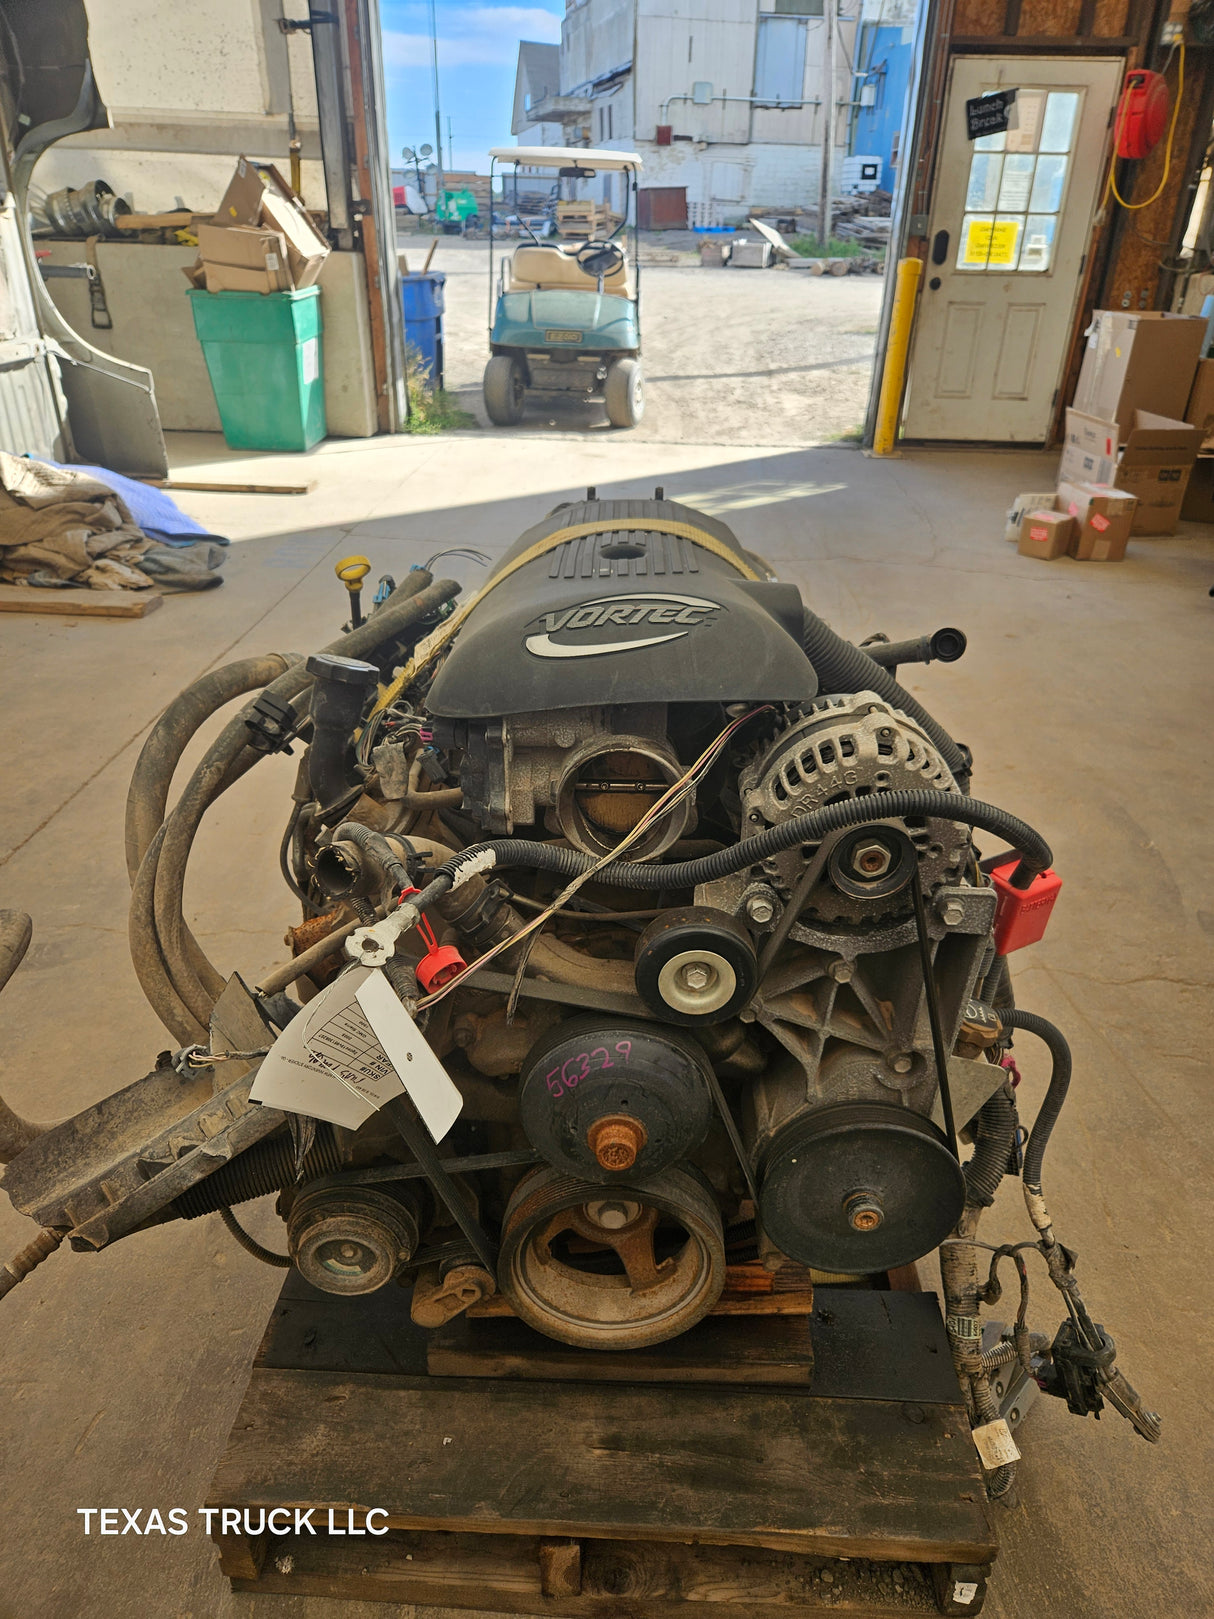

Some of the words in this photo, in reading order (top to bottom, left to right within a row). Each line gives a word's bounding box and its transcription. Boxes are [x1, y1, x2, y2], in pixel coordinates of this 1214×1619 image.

[539, 604, 715, 632] VORTEC
[359, 1066, 381, 1080] SKU#
[374, 1065, 389, 1075] VIN
[546, 1041, 632, 1097] 56329
